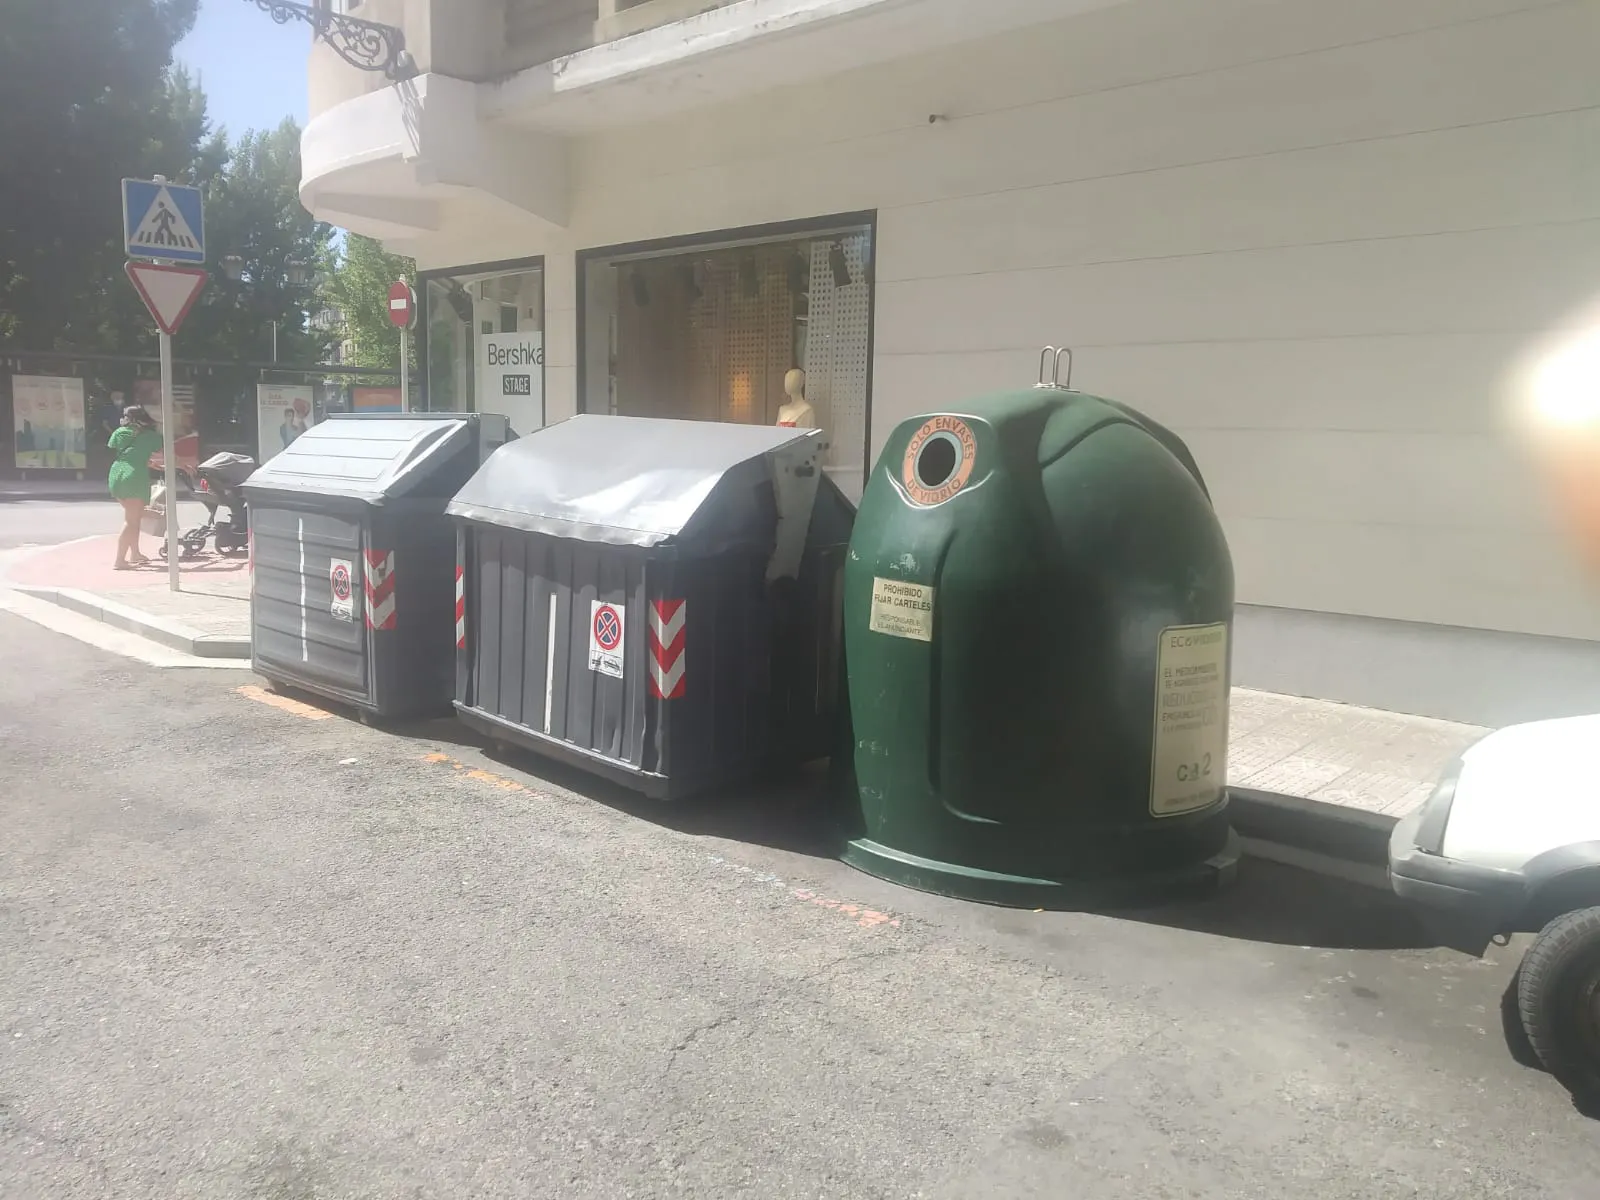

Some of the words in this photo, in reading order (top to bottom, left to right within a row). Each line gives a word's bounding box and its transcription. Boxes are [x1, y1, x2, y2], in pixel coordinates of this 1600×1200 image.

[488, 342, 543, 366] Bershka
[504, 377, 529, 393] STAGE
[908, 425, 931, 460] SOLO
[935, 418, 974, 460] ENVASES
[907, 479, 918, 496] DE
[920, 479, 961, 503] VIDRIO
[884, 584, 922, 598] PROHIBIDO
[875, 594, 892, 605] FIJAR
[894, 598, 931, 612] CARTELES
[1170, 630, 1222, 648] ECOVID
